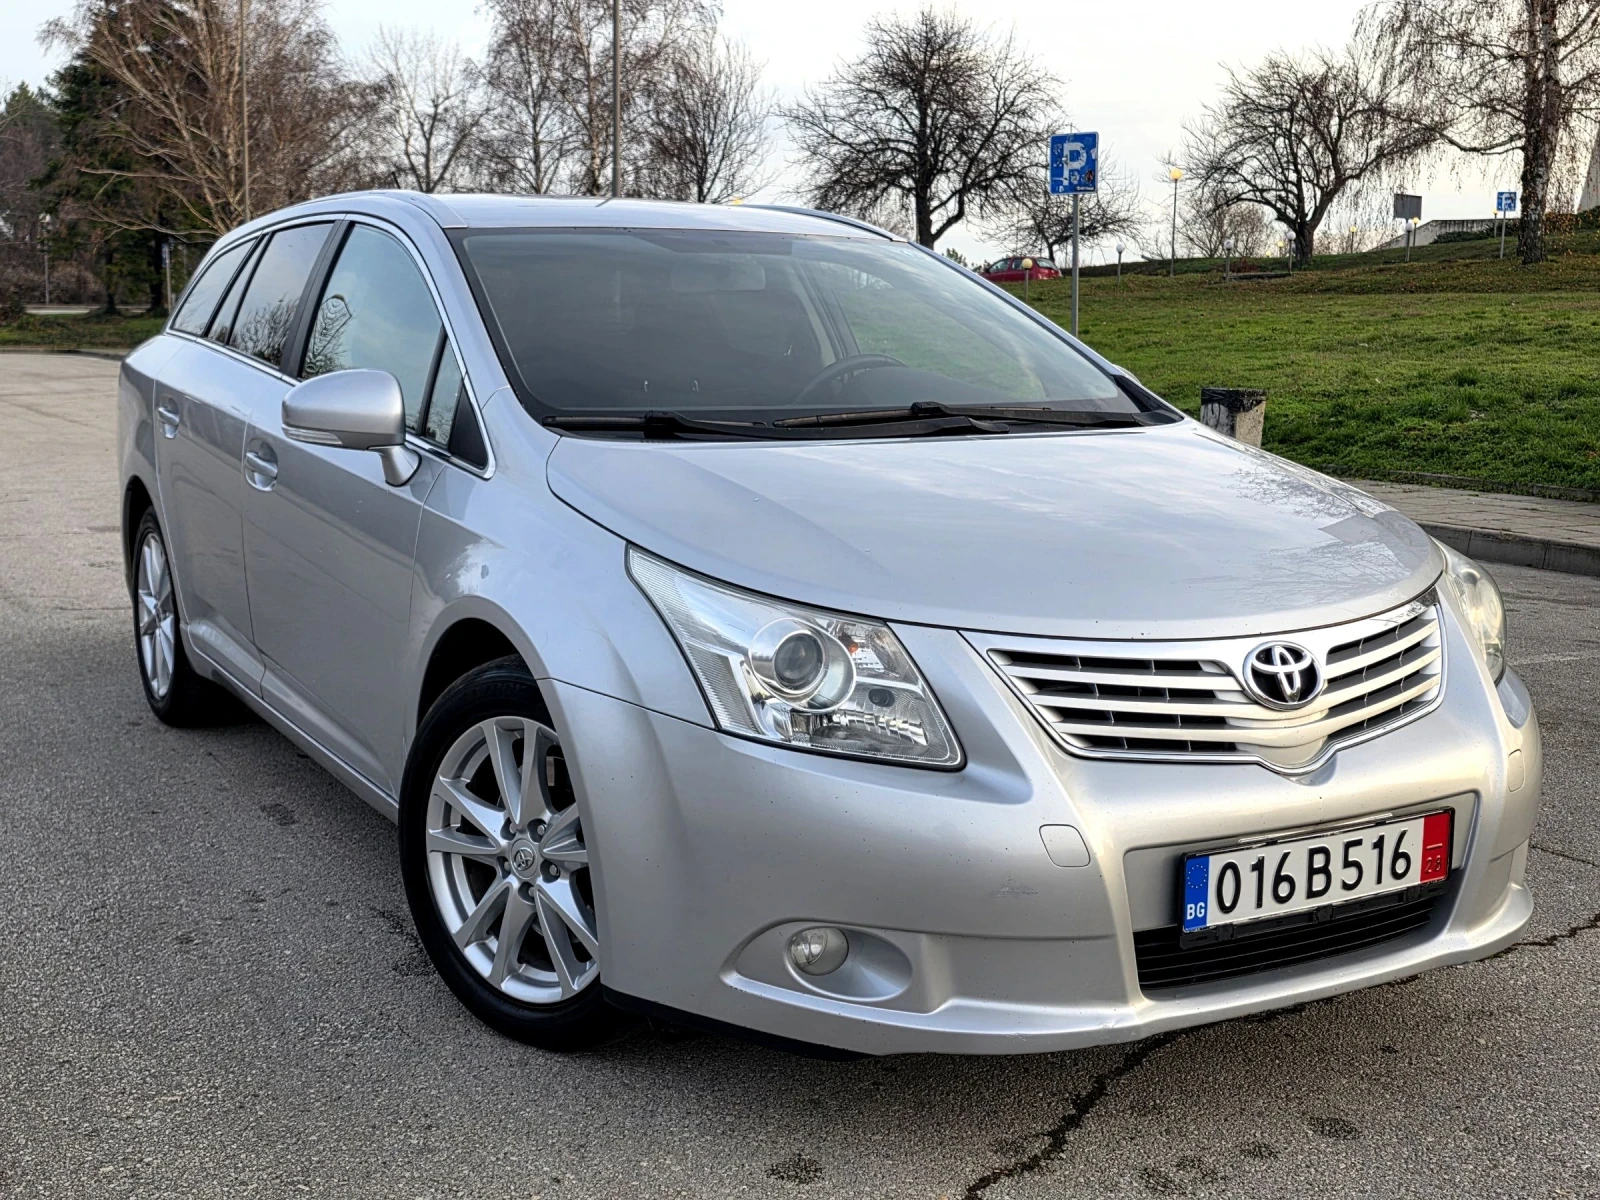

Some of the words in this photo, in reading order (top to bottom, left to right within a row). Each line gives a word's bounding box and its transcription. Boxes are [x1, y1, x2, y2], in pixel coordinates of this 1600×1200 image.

[1063, 142, 1087, 185] P
[1216, 829, 1412, 914] 016B516
[1187, 902, 1205, 920] BG
